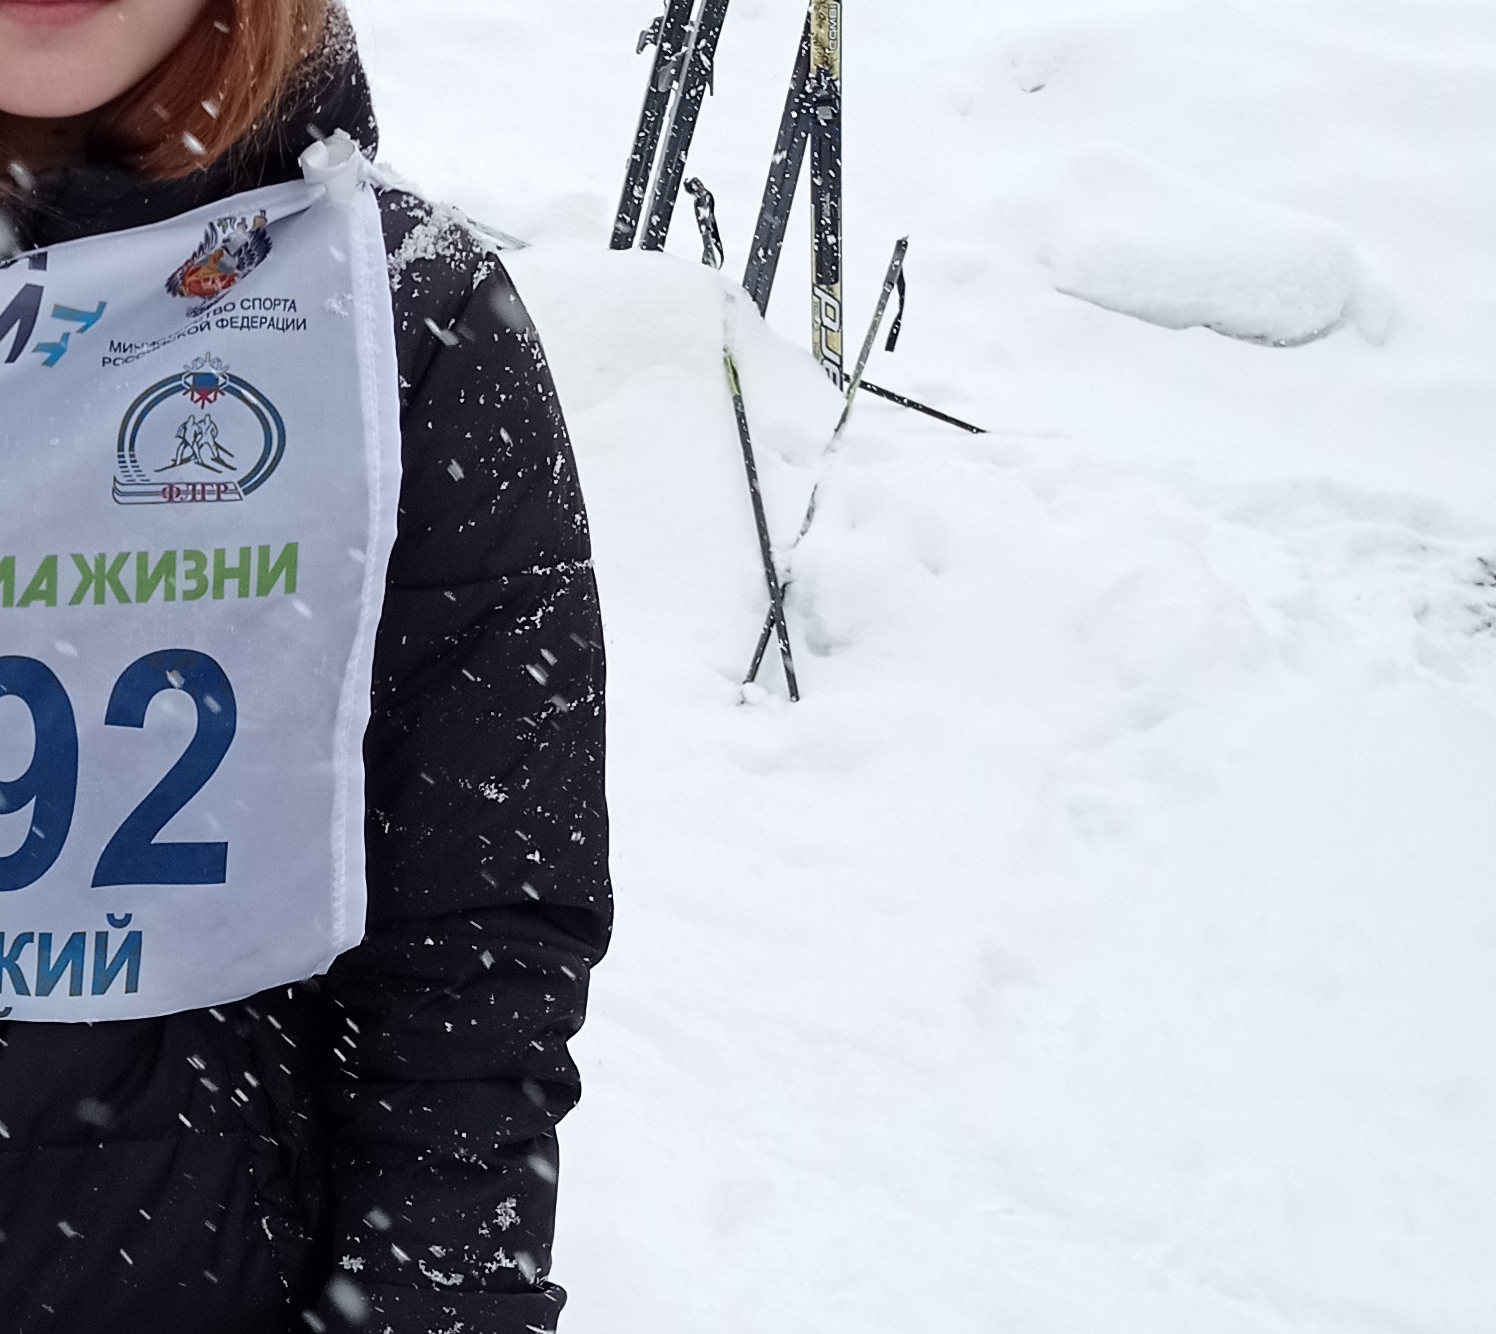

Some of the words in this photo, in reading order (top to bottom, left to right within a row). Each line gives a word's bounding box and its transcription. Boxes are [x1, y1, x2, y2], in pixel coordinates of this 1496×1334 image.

[827, 4, 839, 53] COMBI
[240, 297, 298, 313] СПОРТА
[215, 316, 308, 334] ФЕДЕРАЦИИ
[69, 542, 300, 605] ЖИЗНИ
